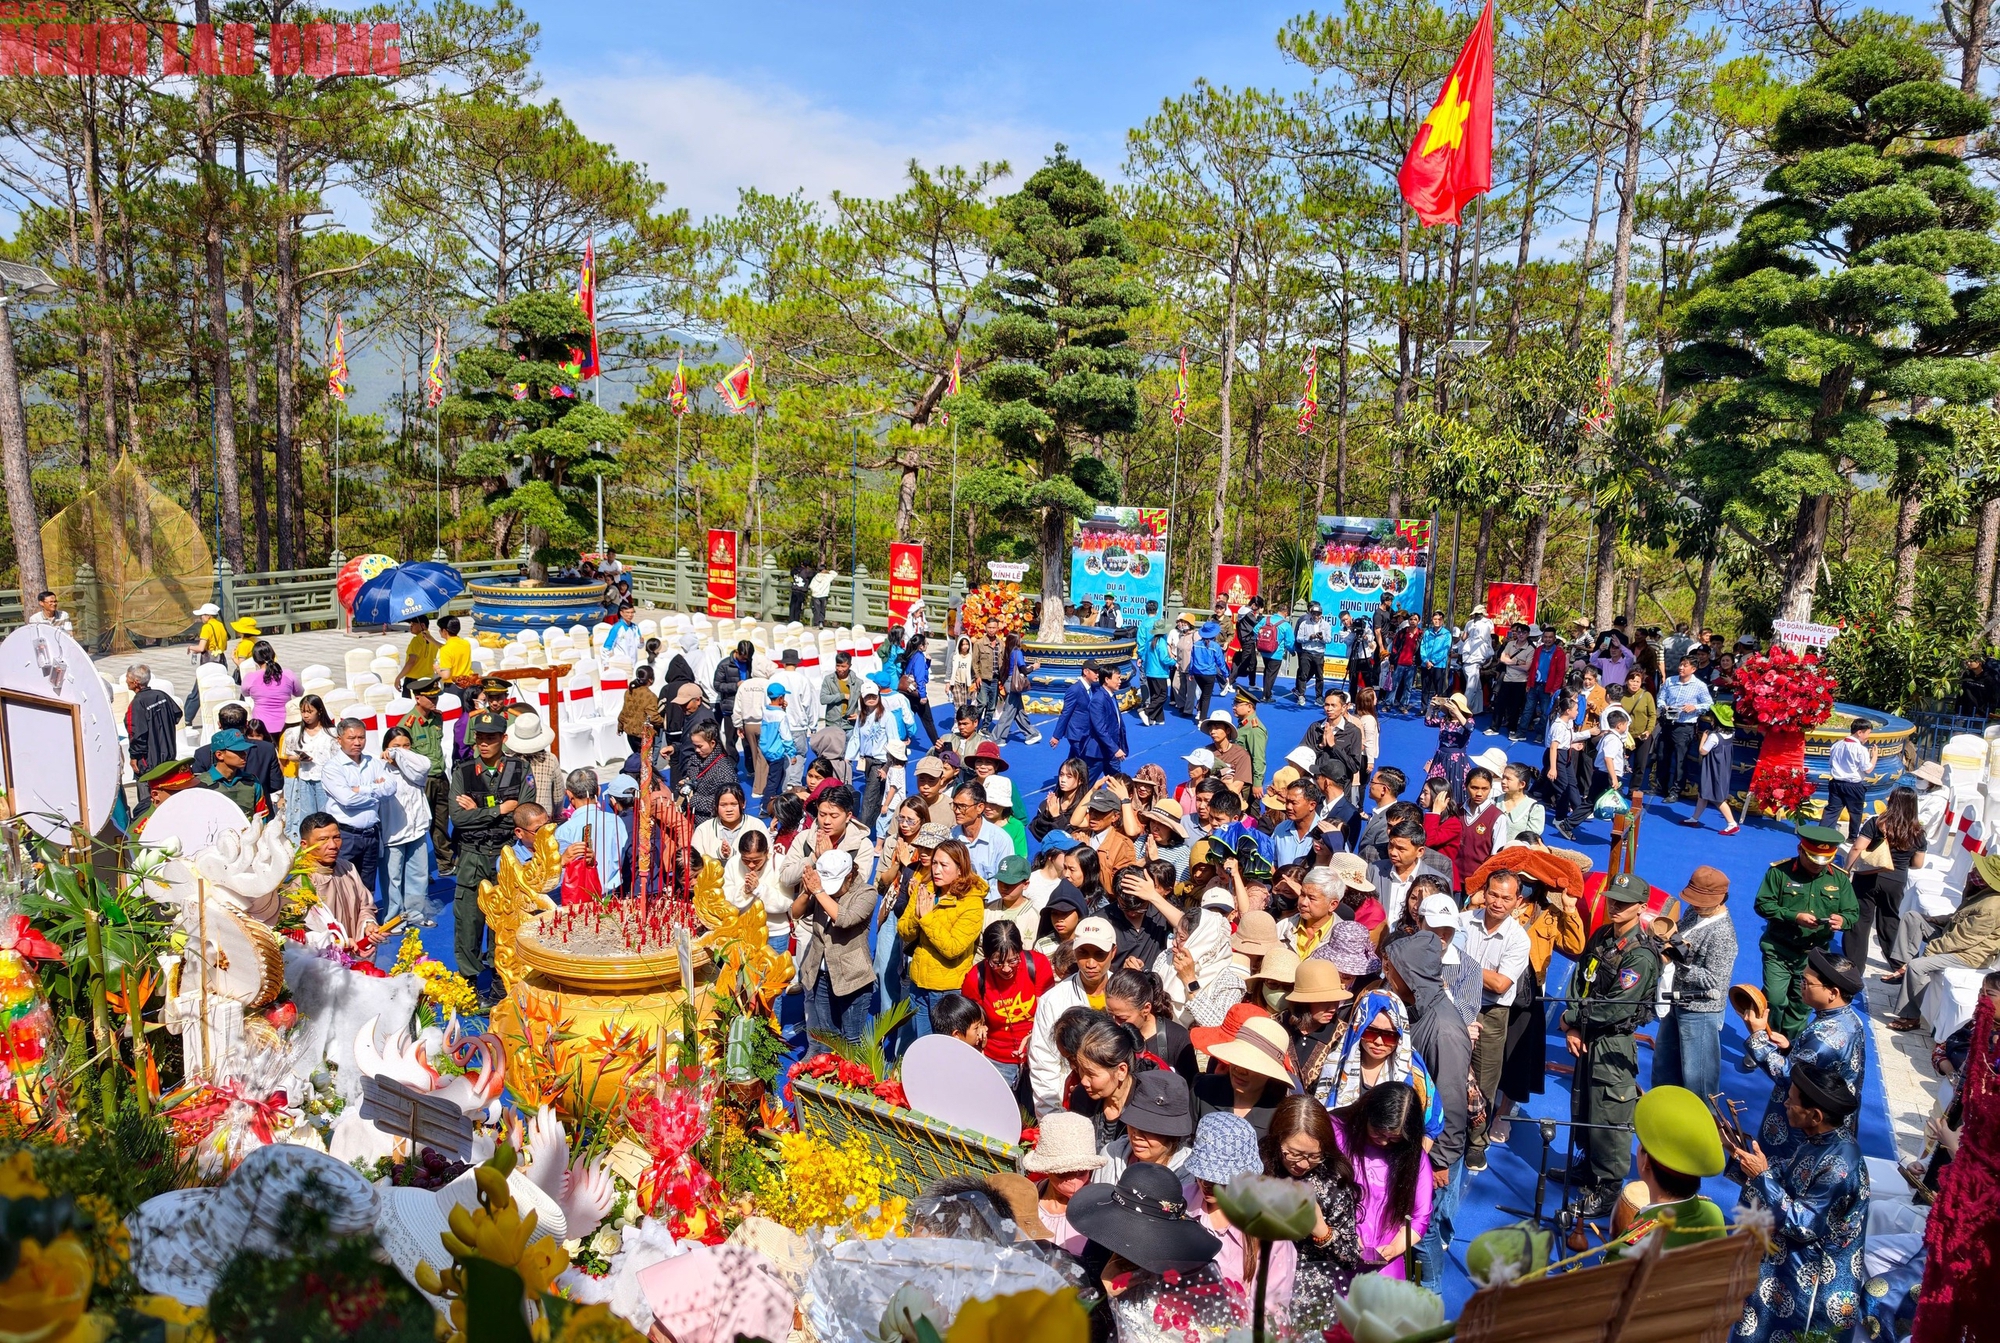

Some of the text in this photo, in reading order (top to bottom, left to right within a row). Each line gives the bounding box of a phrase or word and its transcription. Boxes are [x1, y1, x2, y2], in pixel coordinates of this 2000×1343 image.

[993, 570, 1011, 579] KÍNH
[1340, 598, 1362, 612] HÙNG
[1775, 621, 1786, 630] TẬP
[1786, 622, 1804, 631] ĐOÀN
[1804, 625, 1826, 634] HOÀNG
[1783, 631, 1827, 646] KÍNH LỄ
